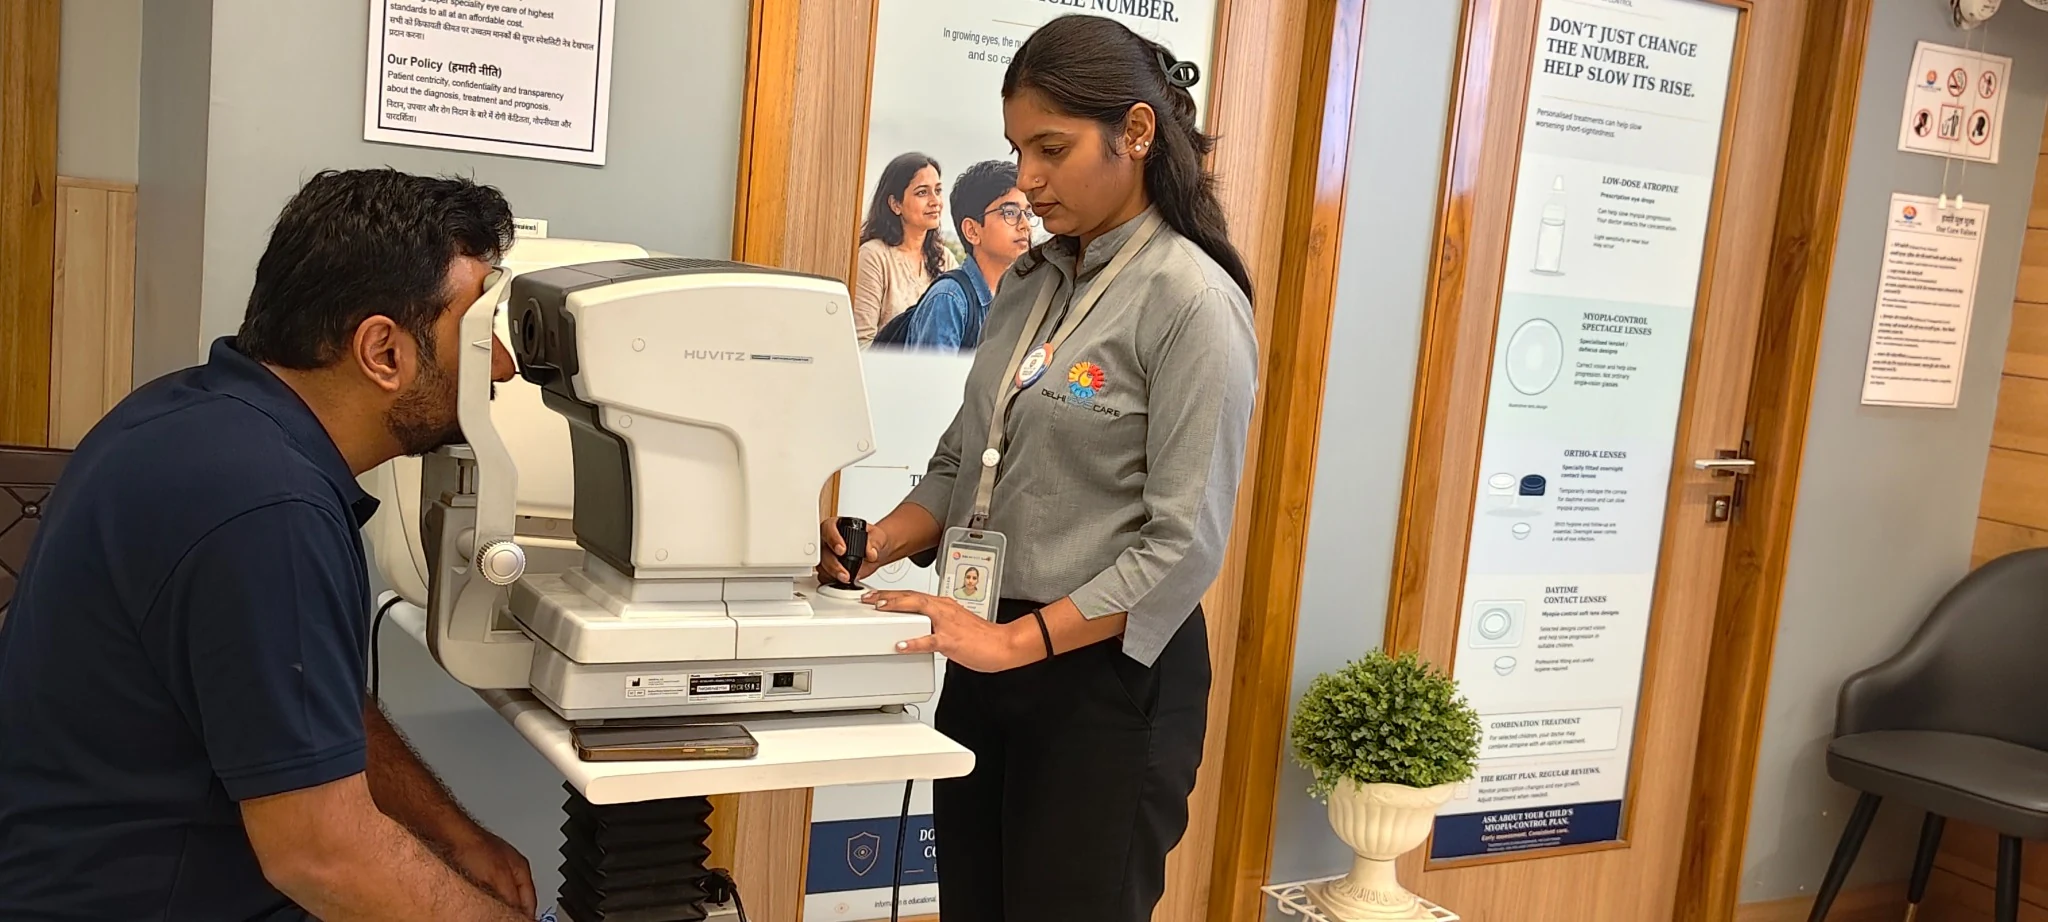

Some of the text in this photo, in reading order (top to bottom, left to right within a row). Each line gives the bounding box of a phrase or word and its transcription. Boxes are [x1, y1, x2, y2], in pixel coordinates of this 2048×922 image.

[390, 3, 427, 14] standards
[429, 8, 437, 16] to
[469, 13, 505, 25] affordable
[451, 0, 485, 11] speciality
[486, 4, 500, 12] eye
[501, 6, 518, 14] care
[528, 8, 554, 19] highest
[1090, 0, 1178, 22] NUMBER.
[944, 28, 951, 38] In
[952, 31, 980, 45] growing
[981, 35, 1000, 46] eyes,
[1002, 36, 1013, 47] the
[1549, 17, 1698, 58] DON'T JUST CHANGE
[968, 50, 1011, 64] and so ca
[1547, 38, 1649, 69] THE NUMBER.
[388, 54, 408, 65] Our
[410, 56, 443, 72] Policy
[478, 64, 502, 79] नीति)
[388, 70, 414, 81] Patient
[452, 80, 502, 94] confidentiality
[518, 87, 564, 101] transparency
[1544, 59, 1695, 98] HELP SLOW ITS RISE.
[387, 84, 408, 94] about
[410, 87, 422, 95] the
[424, 88, 461, 101] diagnosis,
[463, 94, 497, 104] treatment
[514, 101, 550, 111] prognosis.
[1536, 121, 1565, 132] worsening
[1537, 108, 1573, 120] Personalised
[1574, 114, 1604, 125] treatments
[1616, 120, 1629, 130] help
[1602, 176, 1679, 193] LOW-DOSE ATROPINE
[1600, 192, 1630, 200] Prescription
[1583, 312, 1648, 325] MYOPIA-CONTROL
[1582, 323, 1652, 336] SPECTACLE LENSES
[684, 350, 745, 361] HUVITZ
[1042, 388, 1066, 402] DELHI
[1093, 404, 1120, 418] CARE
[1564, 450, 1598, 458] ORTHO-K
[1491, 717, 1581, 729] COMBINATION TREATMENT
[1496, 774, 1517, 782] RIGHT
[1539, 770, 1570, 778] REGULAR
[1482, 808, 1574, 824] ASK ABOUT YOUR CHILD'S
[1484, 819, 1547, 832] MYOPIA-CONTROL
